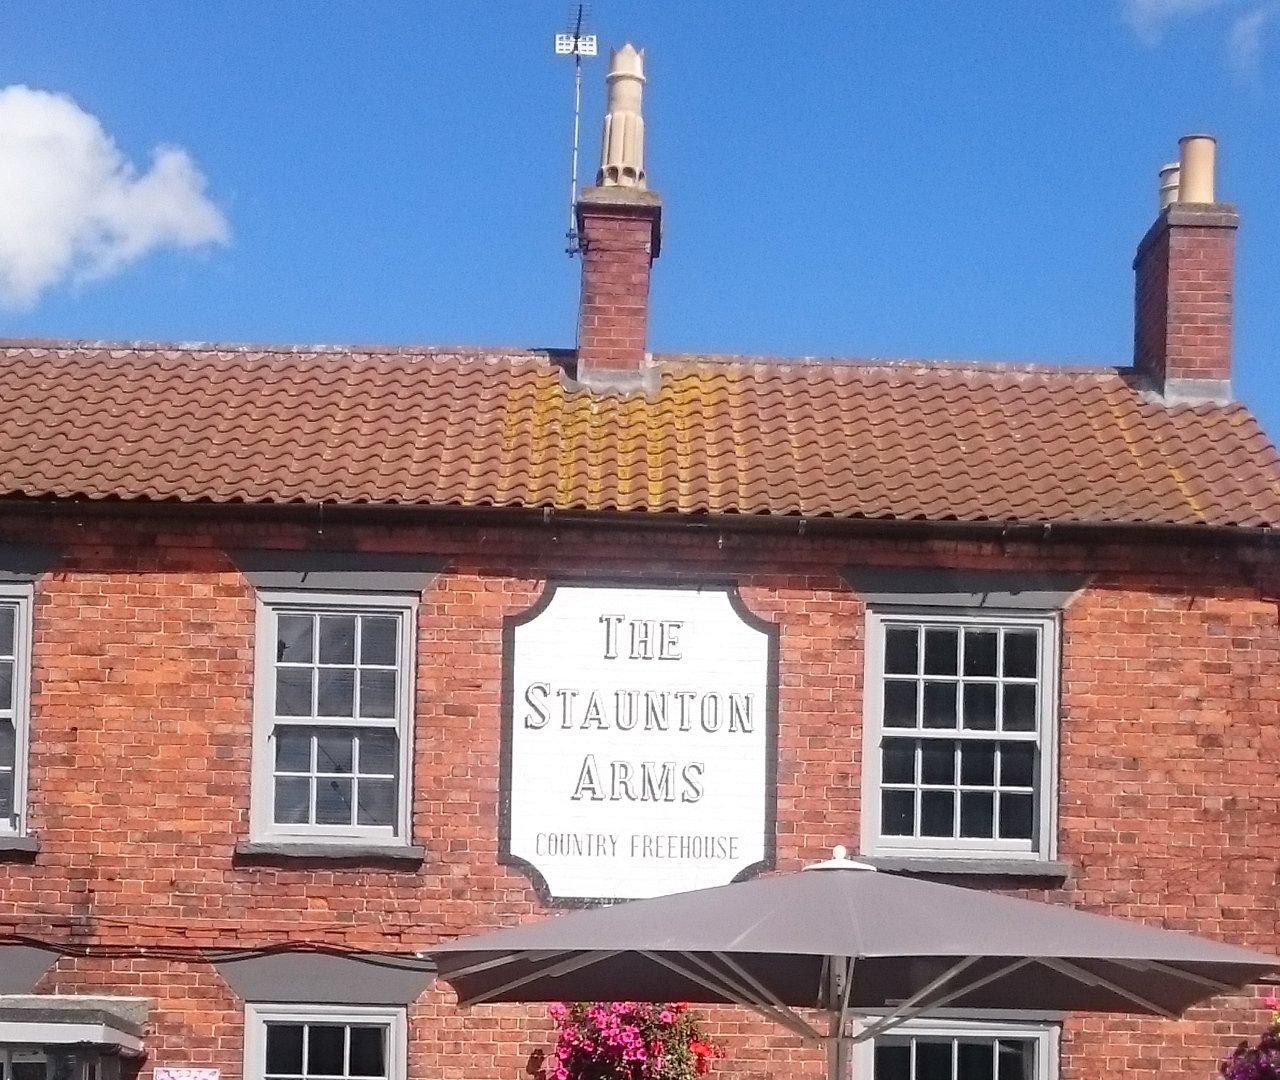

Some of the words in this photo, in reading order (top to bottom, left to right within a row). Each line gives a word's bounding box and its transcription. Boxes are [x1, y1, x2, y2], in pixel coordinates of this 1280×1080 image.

[599, 613, 686, 660] THE
[524, 681, 755, 733] STAUNTON
[570, 753, 705, 803] ARMS
[535, 832, 619, 857] COUNTRY
[630, 834, 740, 860] FREEHOUSE
